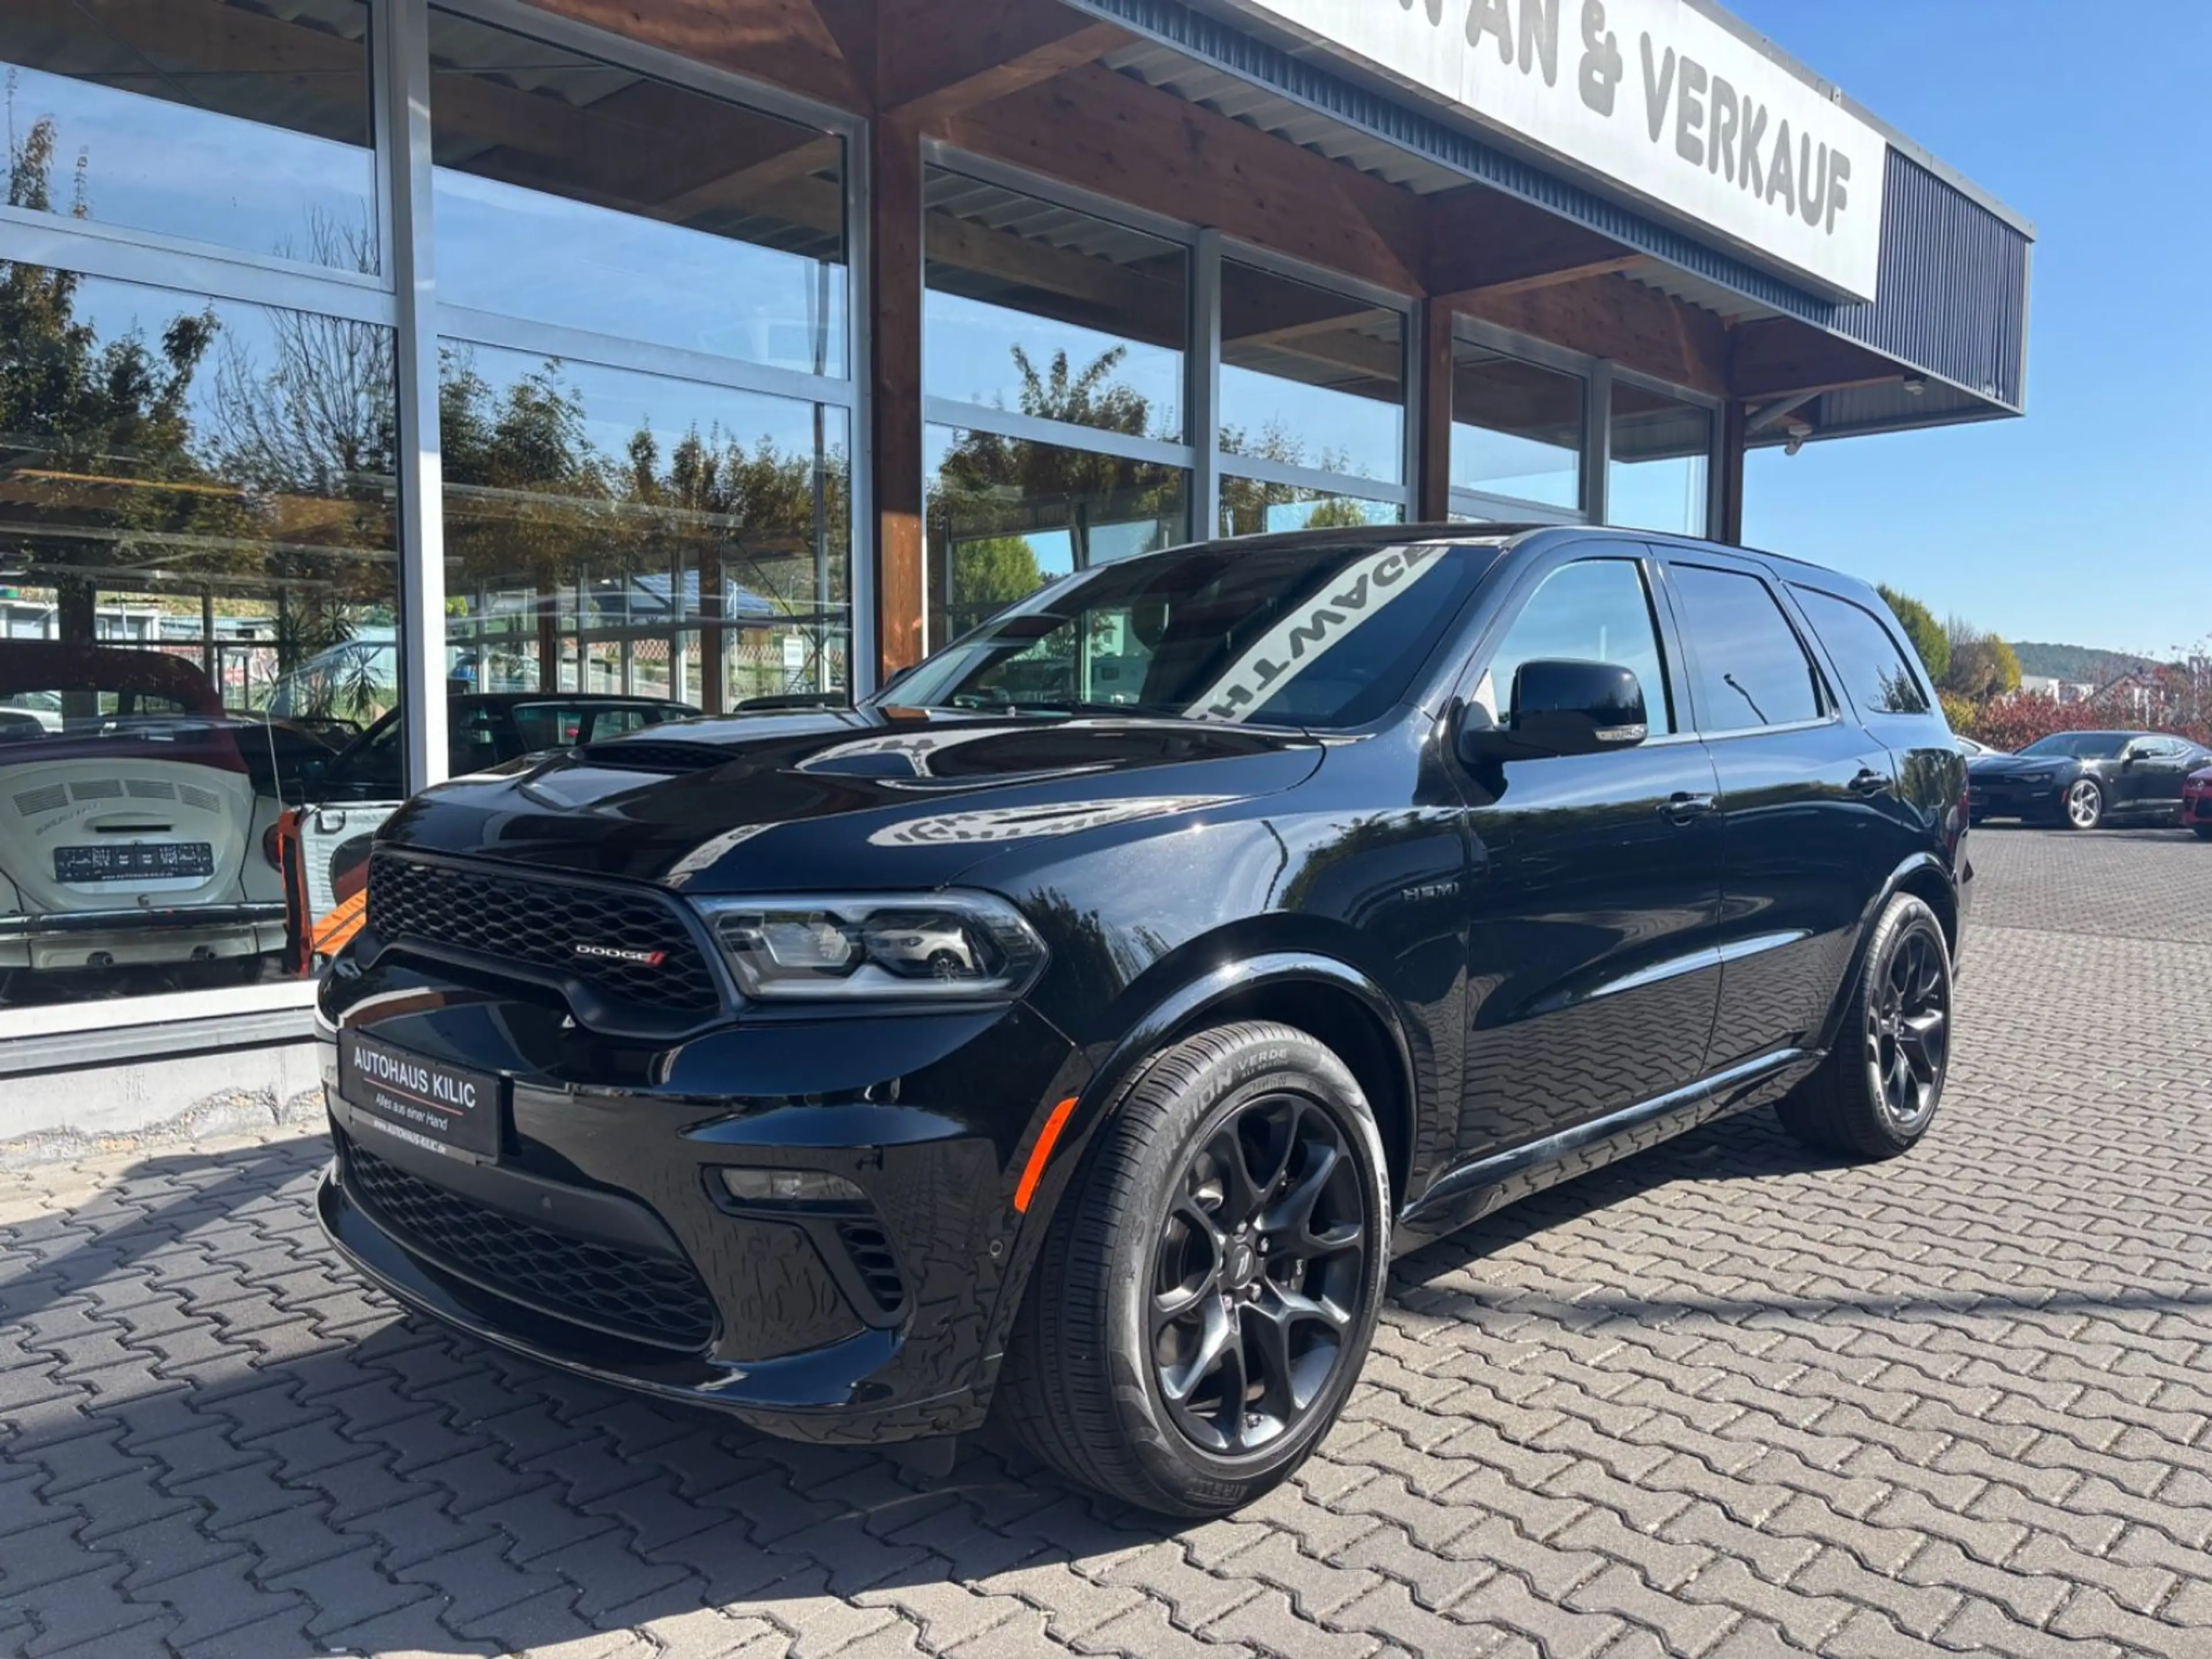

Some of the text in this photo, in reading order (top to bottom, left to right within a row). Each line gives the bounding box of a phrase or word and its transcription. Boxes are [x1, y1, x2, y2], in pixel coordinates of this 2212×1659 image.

[1578, 0, 1623, 118] &
[1639, 30, 1851, 236] VERKAUF
[576, 944, 650, 963] DODGE
[354, 1046, 476, 1108] AUTOHAUS KILIC
[376, 1092, 449, 1132] Alles aus einer Hand
